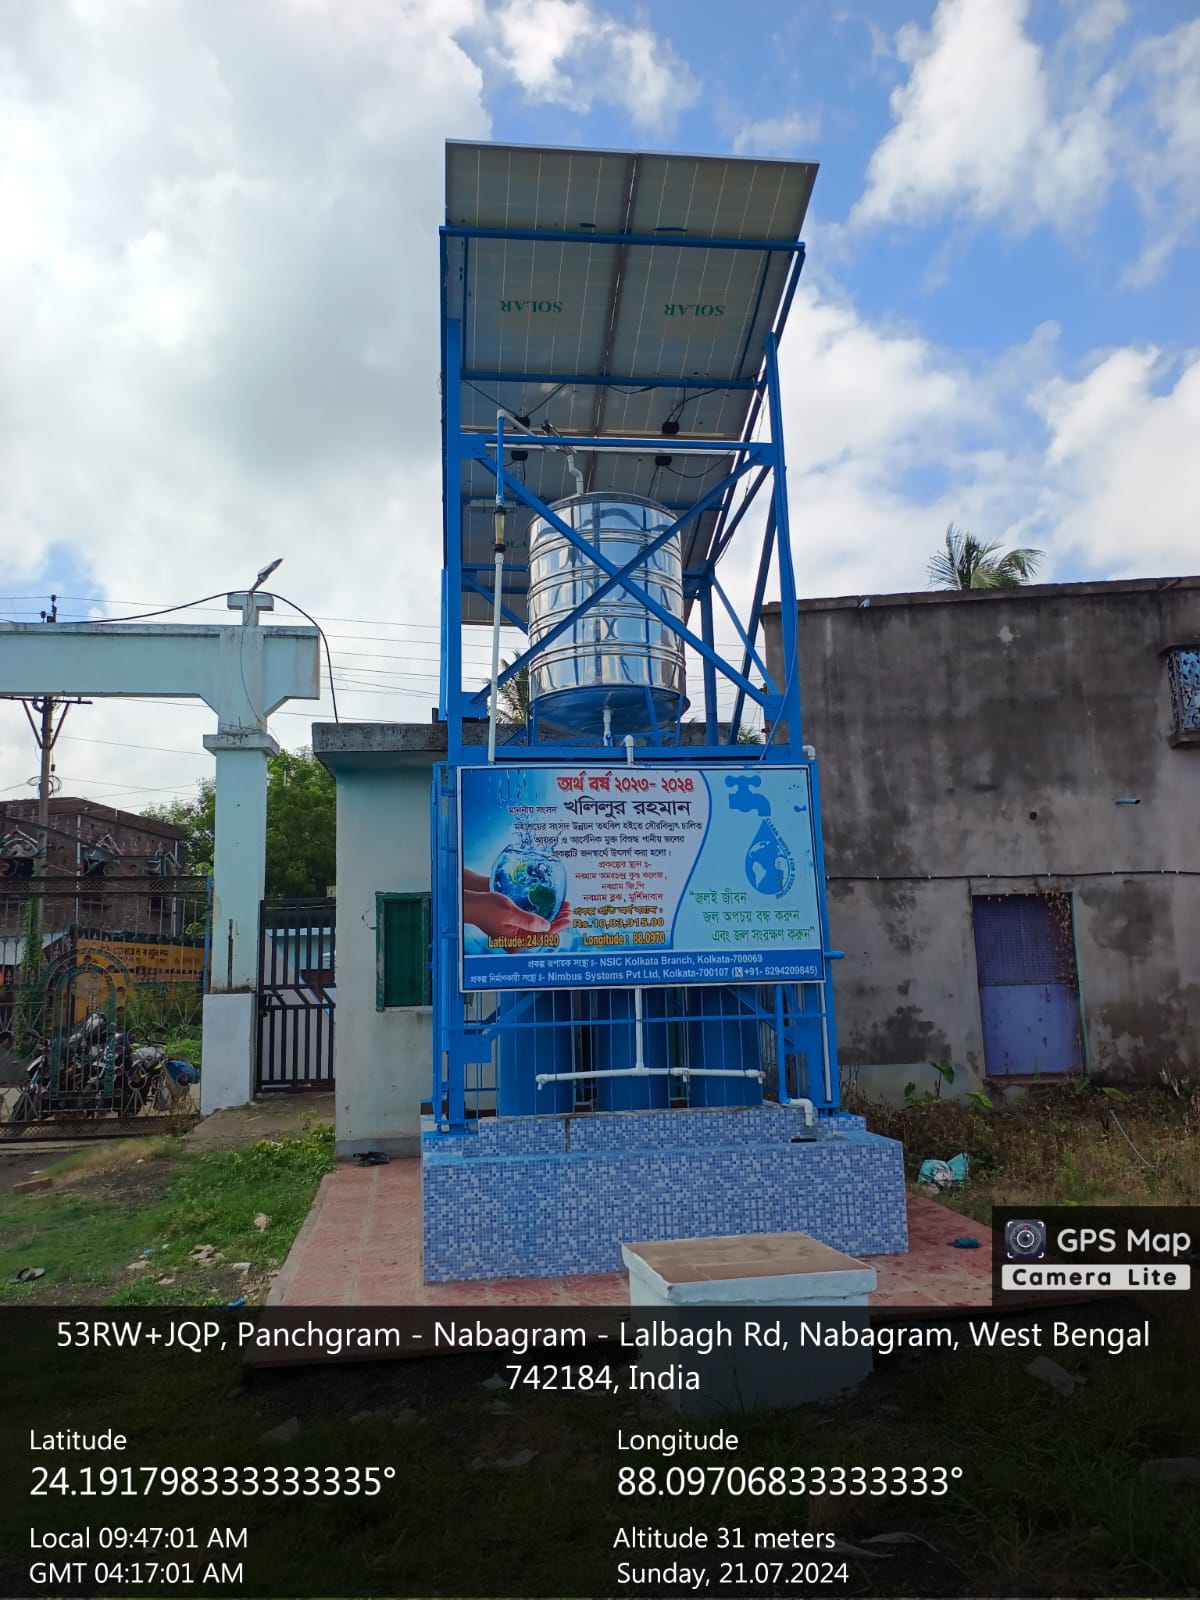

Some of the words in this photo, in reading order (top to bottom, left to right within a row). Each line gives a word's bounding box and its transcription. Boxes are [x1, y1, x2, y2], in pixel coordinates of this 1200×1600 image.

[500, 299, 562, 313] SOLAR
[664, 303, 725, 317] SOLAR
[556, 770, 587, 792] অর্থ
[588, 771, 613, 792] বর্ষ
[563, 795, 627, 819] খলিলুর
[631, 800, 692, 816] রহমান
[721, 887, 748, 905] জীবন
[702, 910, 719, 924] জল
[712, 930, 730, 943] এবং
[734, 929, 749, 943] জল
[599, 957, 622, 967] NSIC
[624, 956, 658, 966] Kolkata
[661, 956, 695, 967] Branch,
[697, 954, 763, 965] Kolkata-700069
[547, 971, 583, 982] Nimbus
[584, 970, 623, 983] Systems
[626, 969, 641, 980] Pvt
[662, 967, 729, 979] Kolkata-700107
